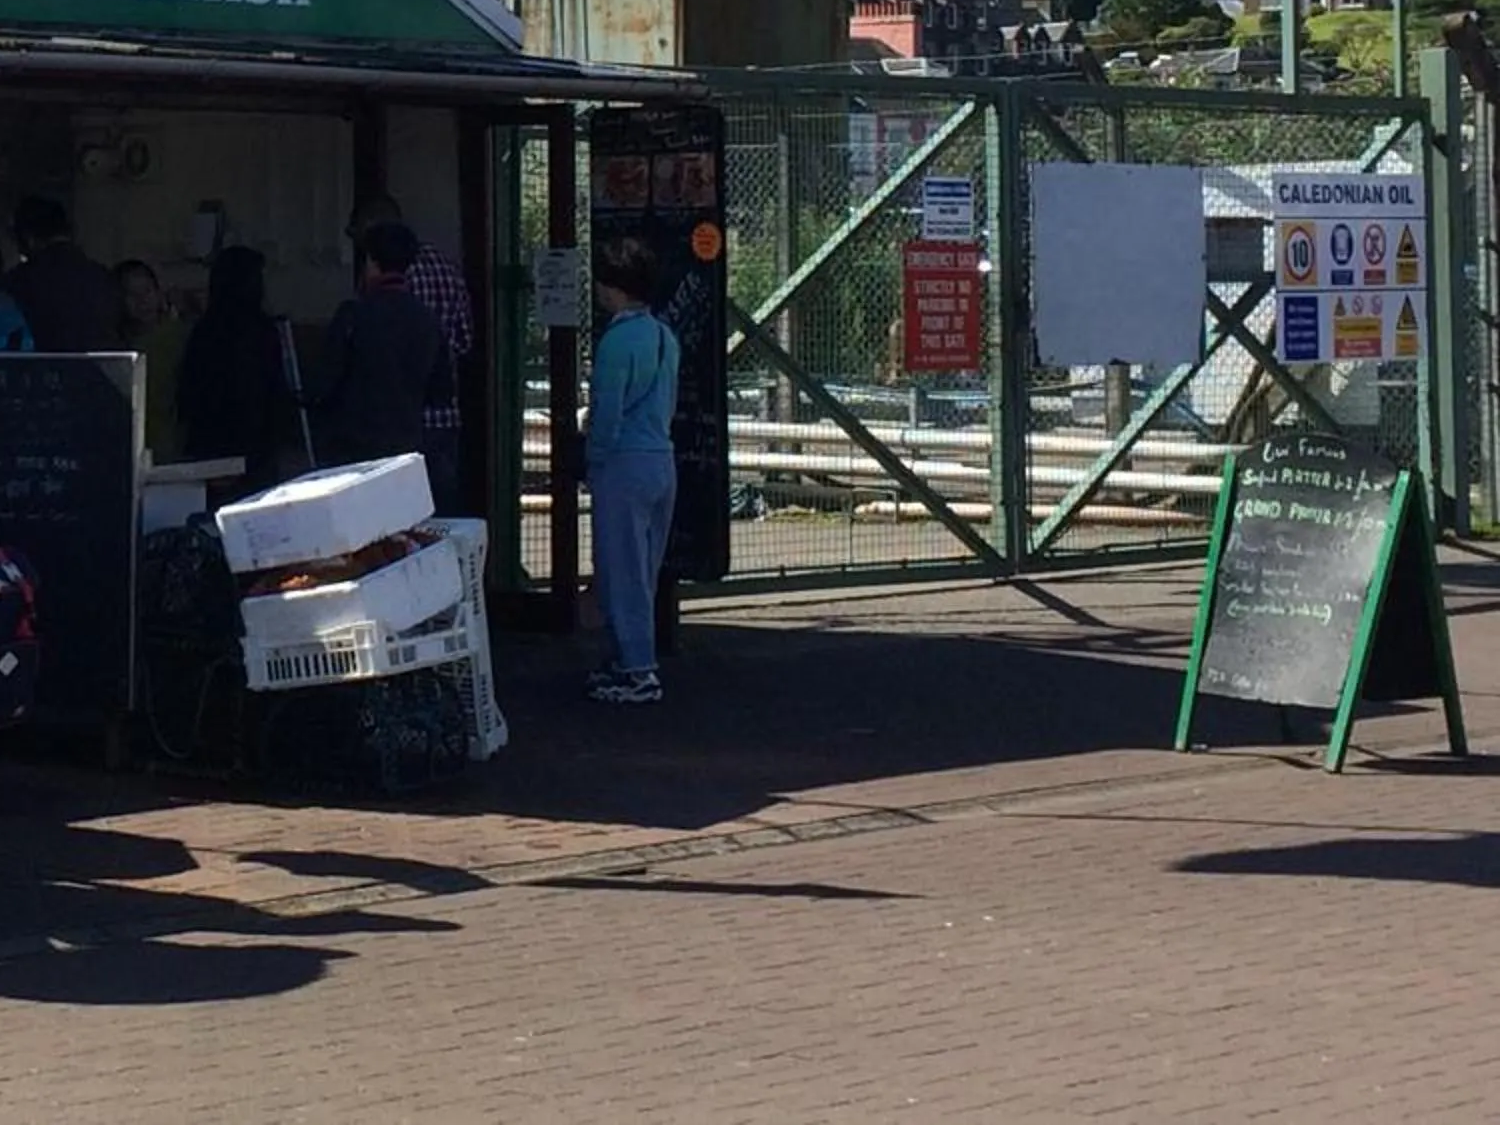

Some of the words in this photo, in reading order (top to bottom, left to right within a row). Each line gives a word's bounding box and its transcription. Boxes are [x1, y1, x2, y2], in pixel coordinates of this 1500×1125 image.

[1279, 183, 1383, 204] CALEDONIAN
[1389, 185, 1414, 204] OIL
[1291, 239, 1309, 268] 10
